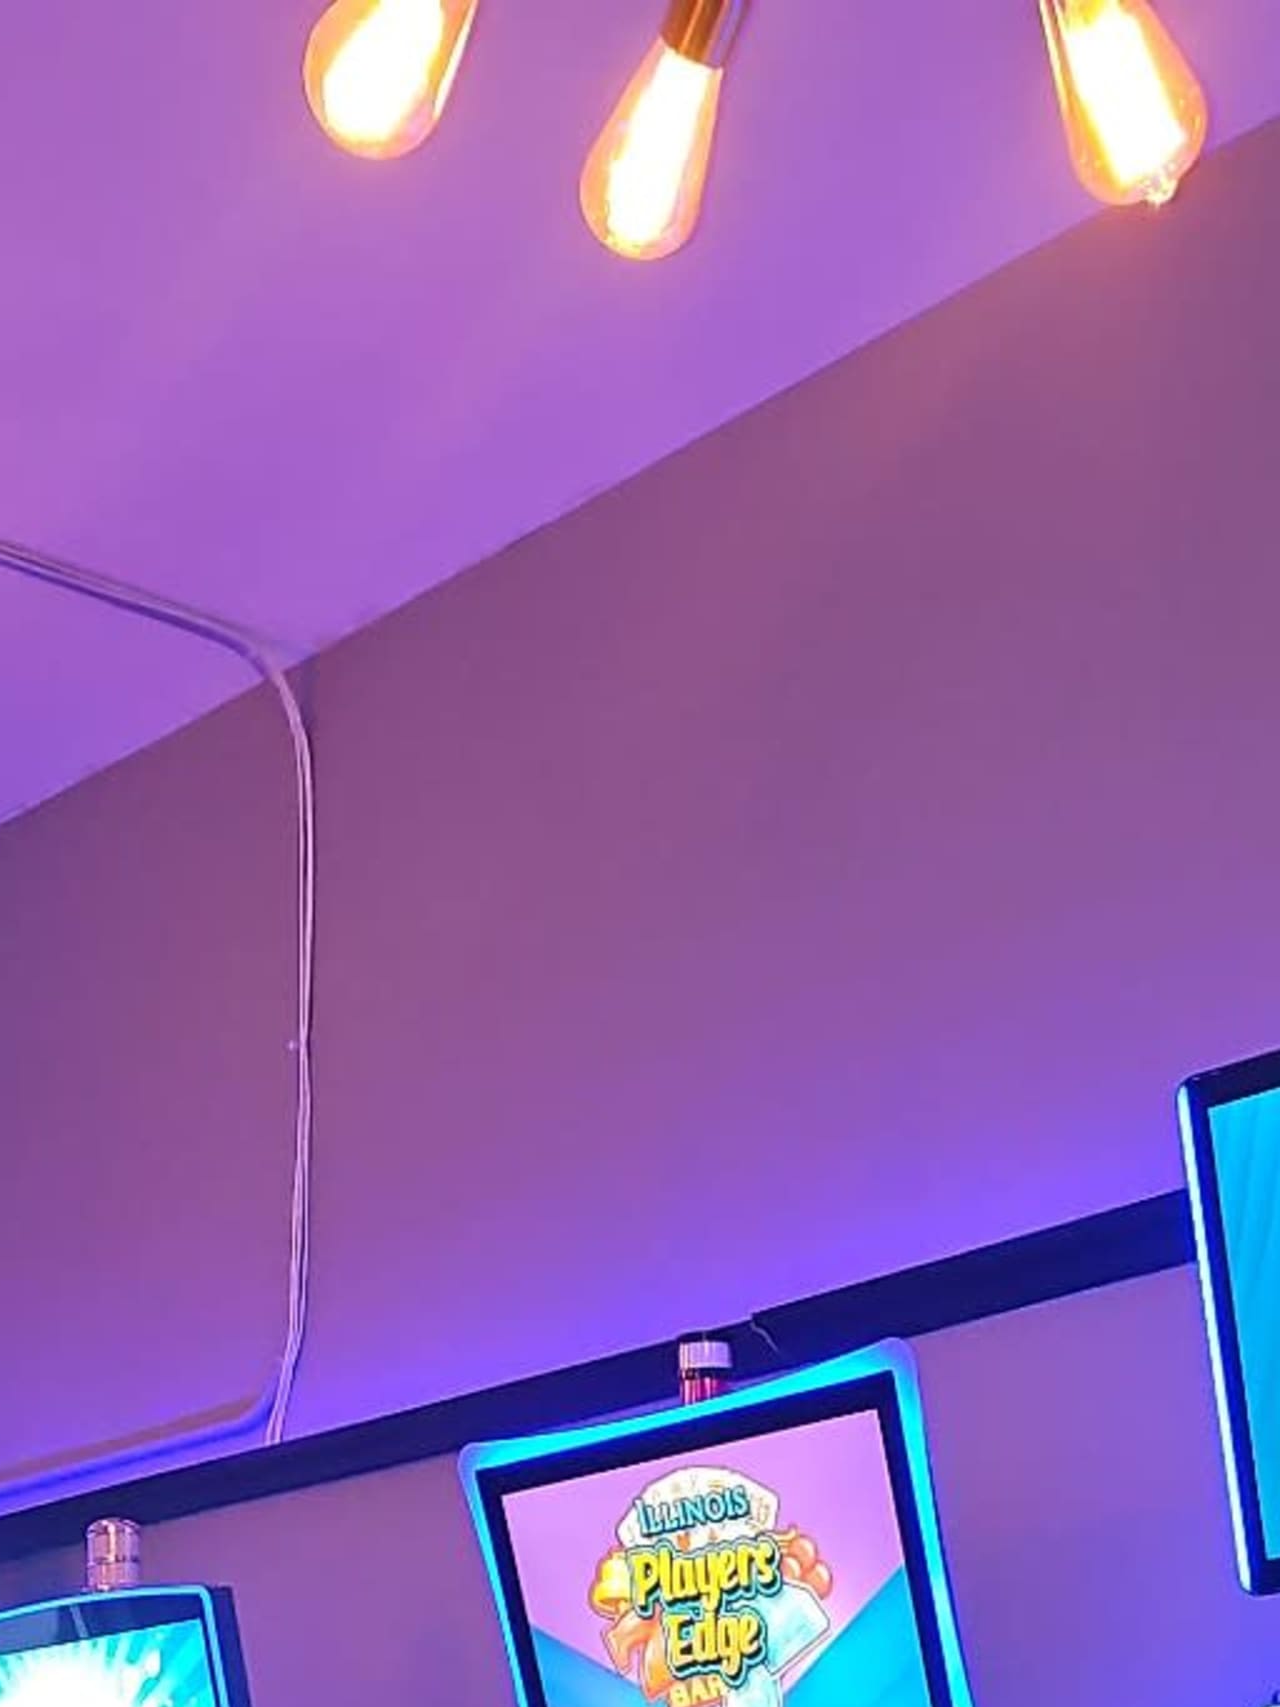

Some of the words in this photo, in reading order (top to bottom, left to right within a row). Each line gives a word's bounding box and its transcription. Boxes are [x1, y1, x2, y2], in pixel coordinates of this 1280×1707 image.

[634, 1484, 750, 1537] ILLINOIS
[629, 1537, 781, 1613] Players
[663, 1607, 765, 1681] Edge
